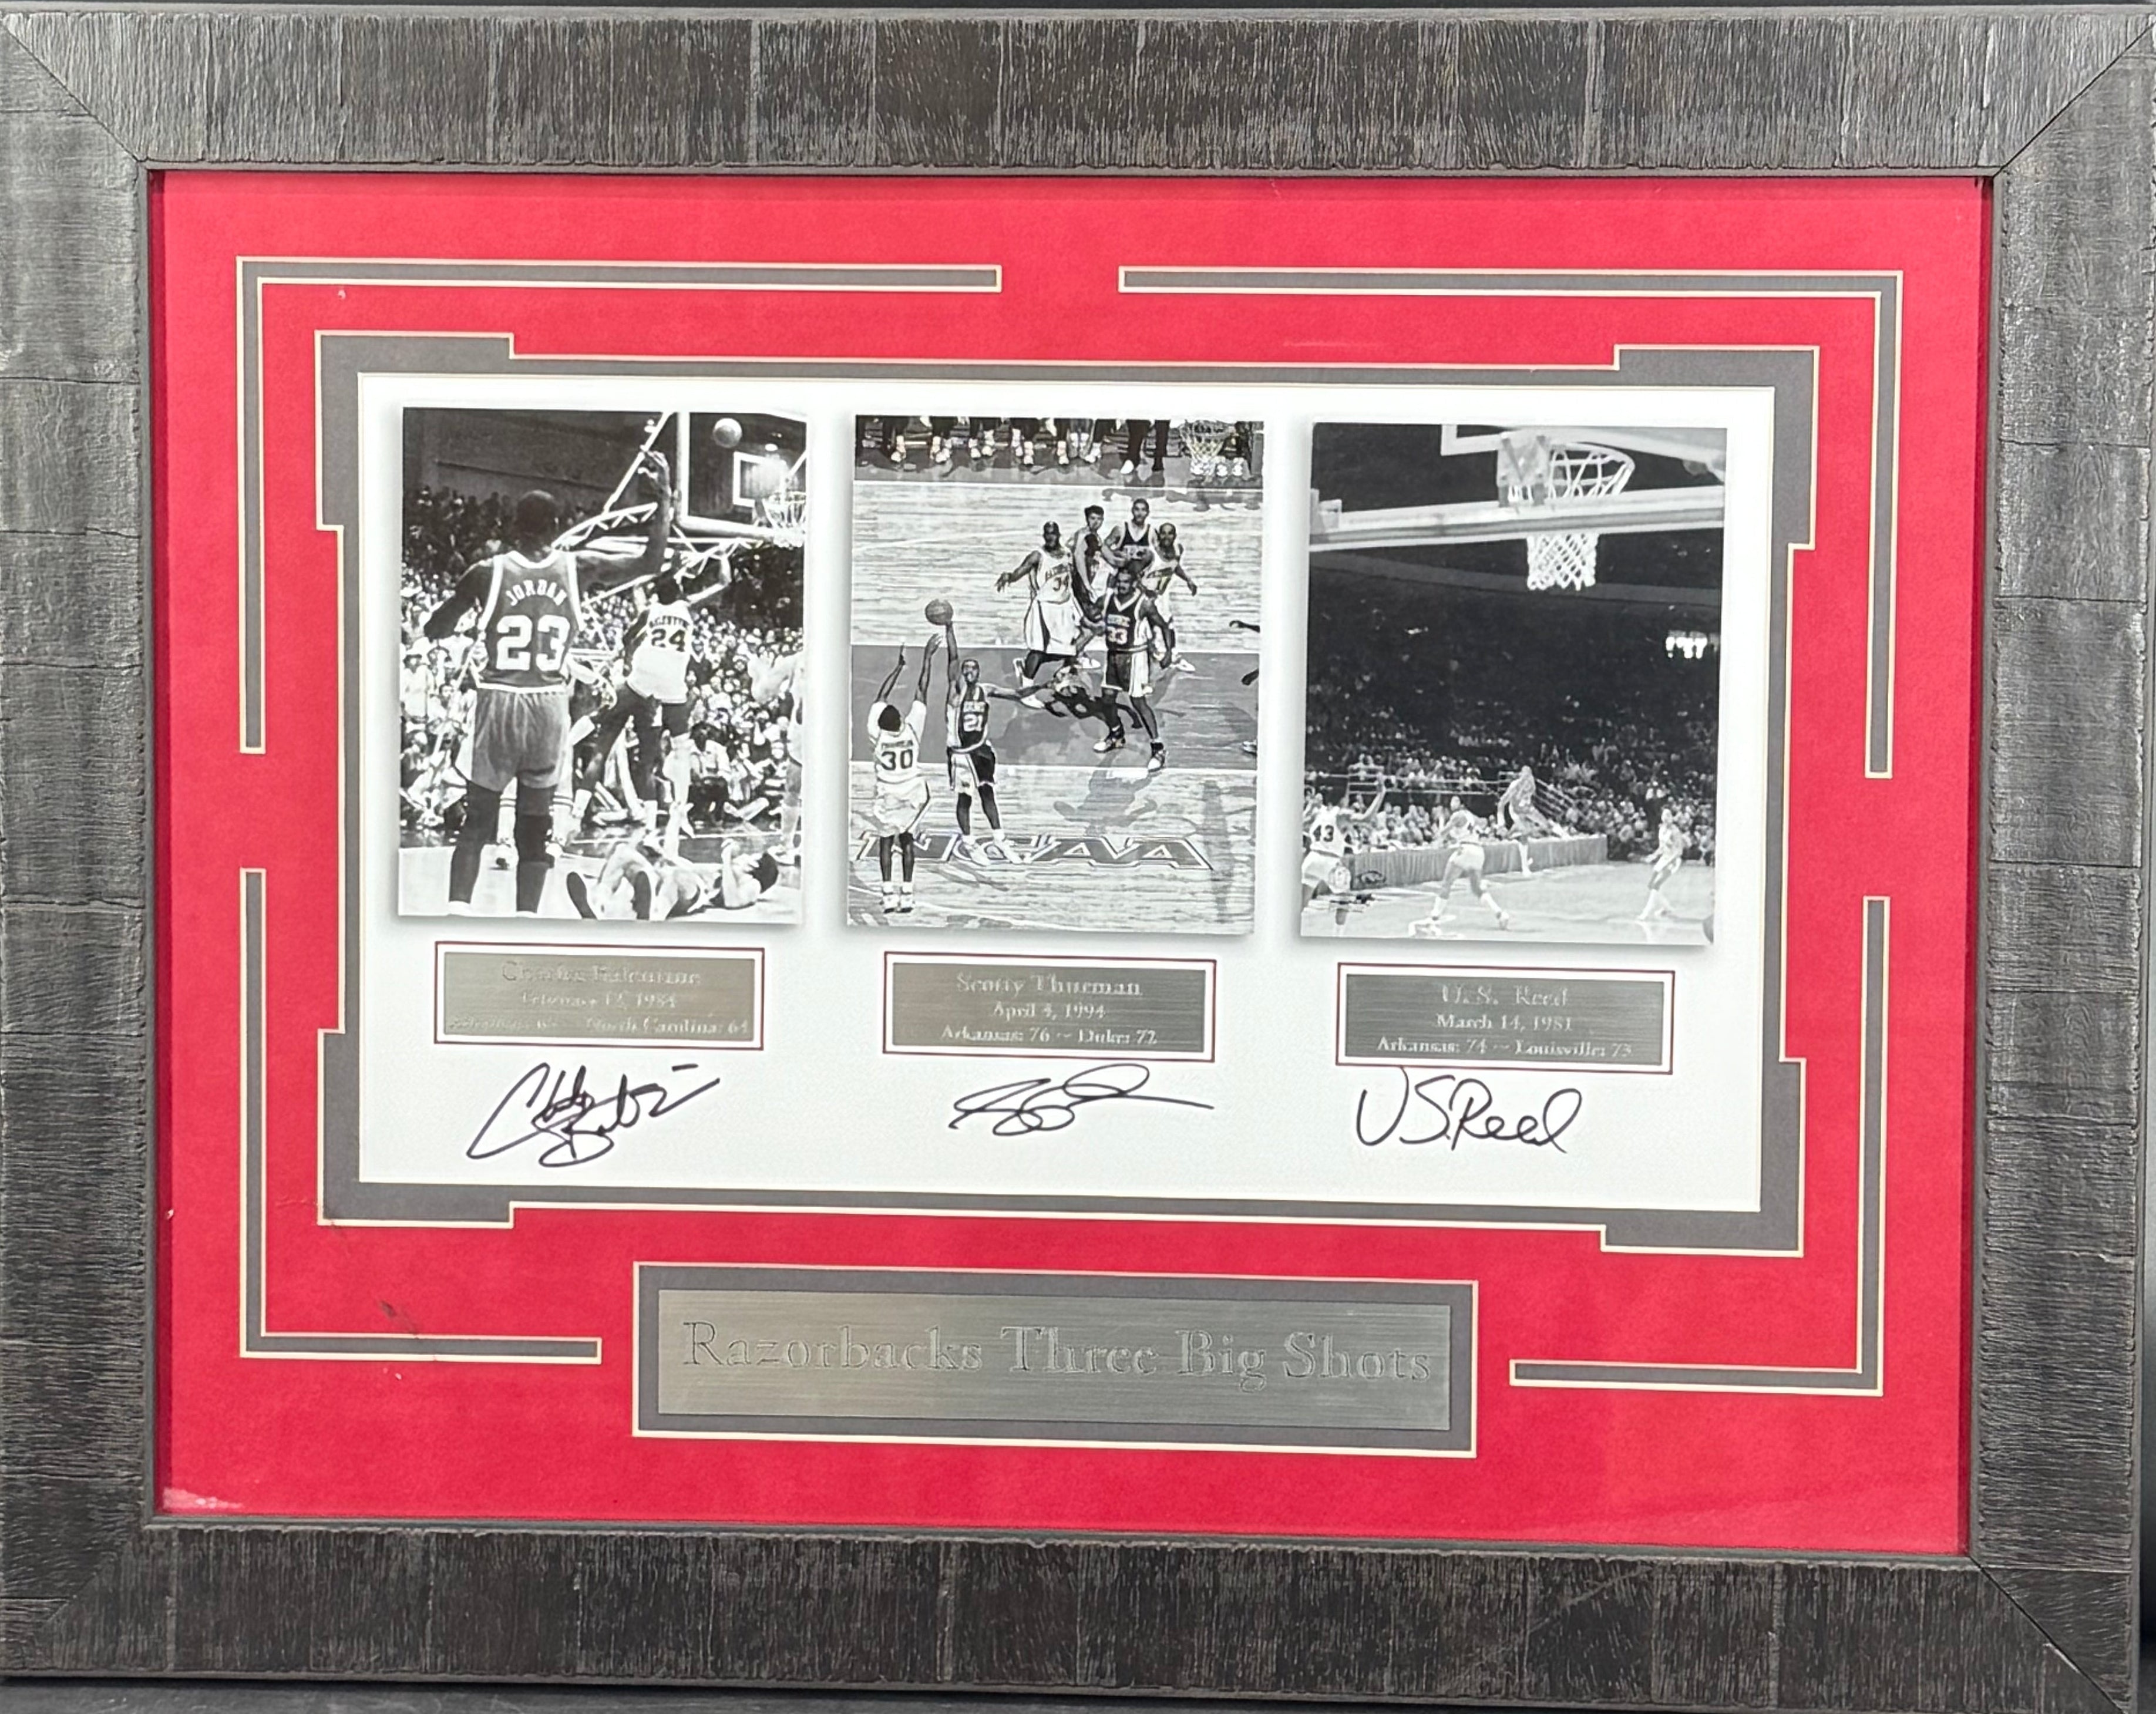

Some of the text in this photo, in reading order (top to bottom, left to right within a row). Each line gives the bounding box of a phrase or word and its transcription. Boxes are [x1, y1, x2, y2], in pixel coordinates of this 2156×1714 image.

[496, 614, 570, 671] 23
[651, 628, 685, 652] 24
[964, 714, 983, 732] 21
[882, 749, 913, 770] 30
[956, 972, 1143, 997] Scotty Thurman
[1513, 986, 1569, 1006] Reed
[993, 1001, 1035, 1021] April
[1064, 1003, 1106, 1019] 1994
[1436, 1013, 1573, 1033] March 14, 1981
[1030, 1026, 1050, 1043] 76
[1136, 1030, 1158, 1045] 72
[1467, 1038, 1486, 1055] 74
[1611, 1043, 1632, 1058] 73
[683, 1321, 1432, 1393] Razorbacks Three Big Shots
